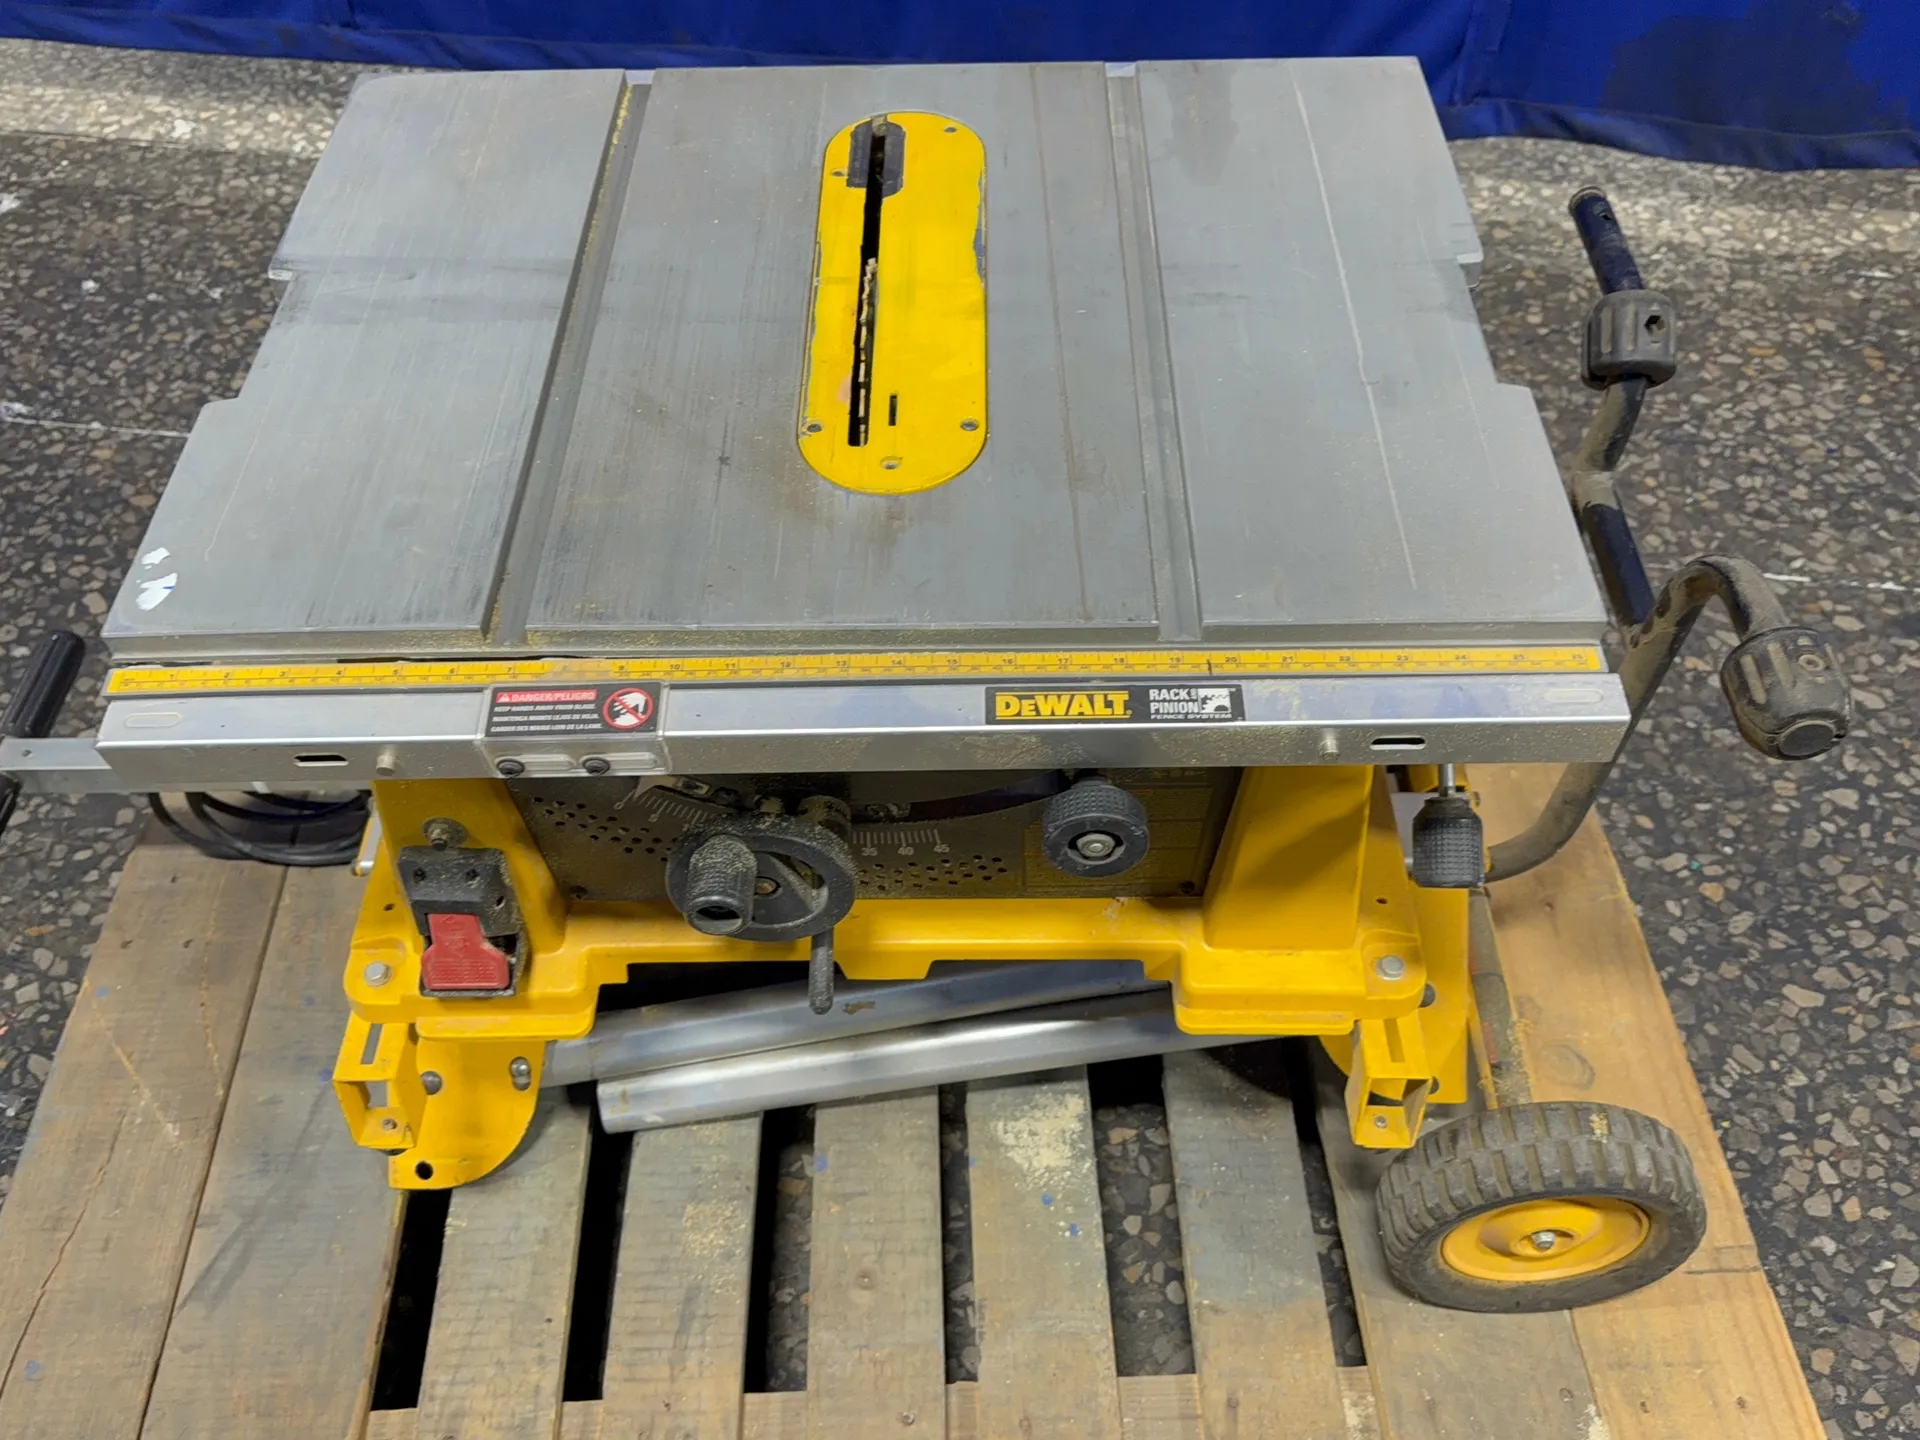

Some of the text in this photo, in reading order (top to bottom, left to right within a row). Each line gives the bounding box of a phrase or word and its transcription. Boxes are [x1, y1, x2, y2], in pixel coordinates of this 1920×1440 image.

[510, 691, 596, 702] DANGER/PELIGRO
[1149, 688, 1190, 700] RACK
[1149, 701, 1199, 714] PINION
[613, 801, 625, 810] 0
[648, 813, 660, 823] 5
[861, 843, 950, 857] 35 40 45
